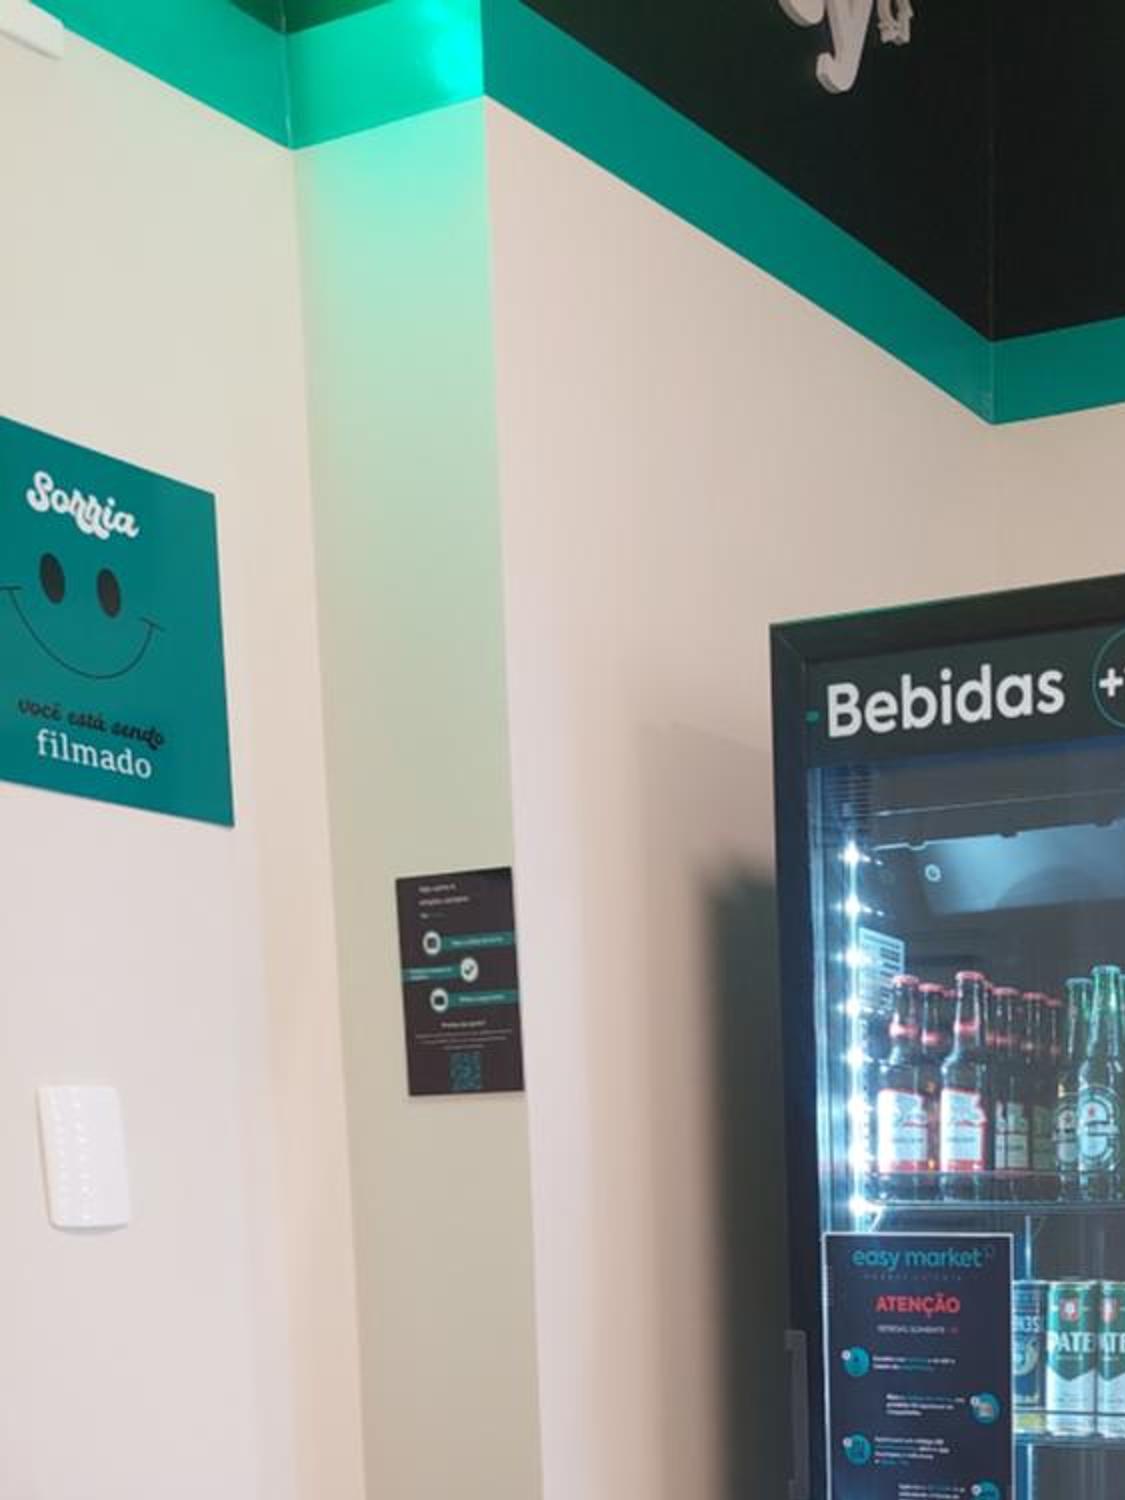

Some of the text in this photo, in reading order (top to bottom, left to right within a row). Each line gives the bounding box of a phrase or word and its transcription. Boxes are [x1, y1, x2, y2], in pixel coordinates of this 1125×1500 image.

[26, 470, 140, 540] Sorria
[17, 697, 165, 750] você está sendo
[826, 663, 1066, 738] Bebidas
[37, 728, 152, 779] filmado
[852, 1247, 984, 1272] easy market
[873, 1291, 962, 1319] ATENÇÃO
